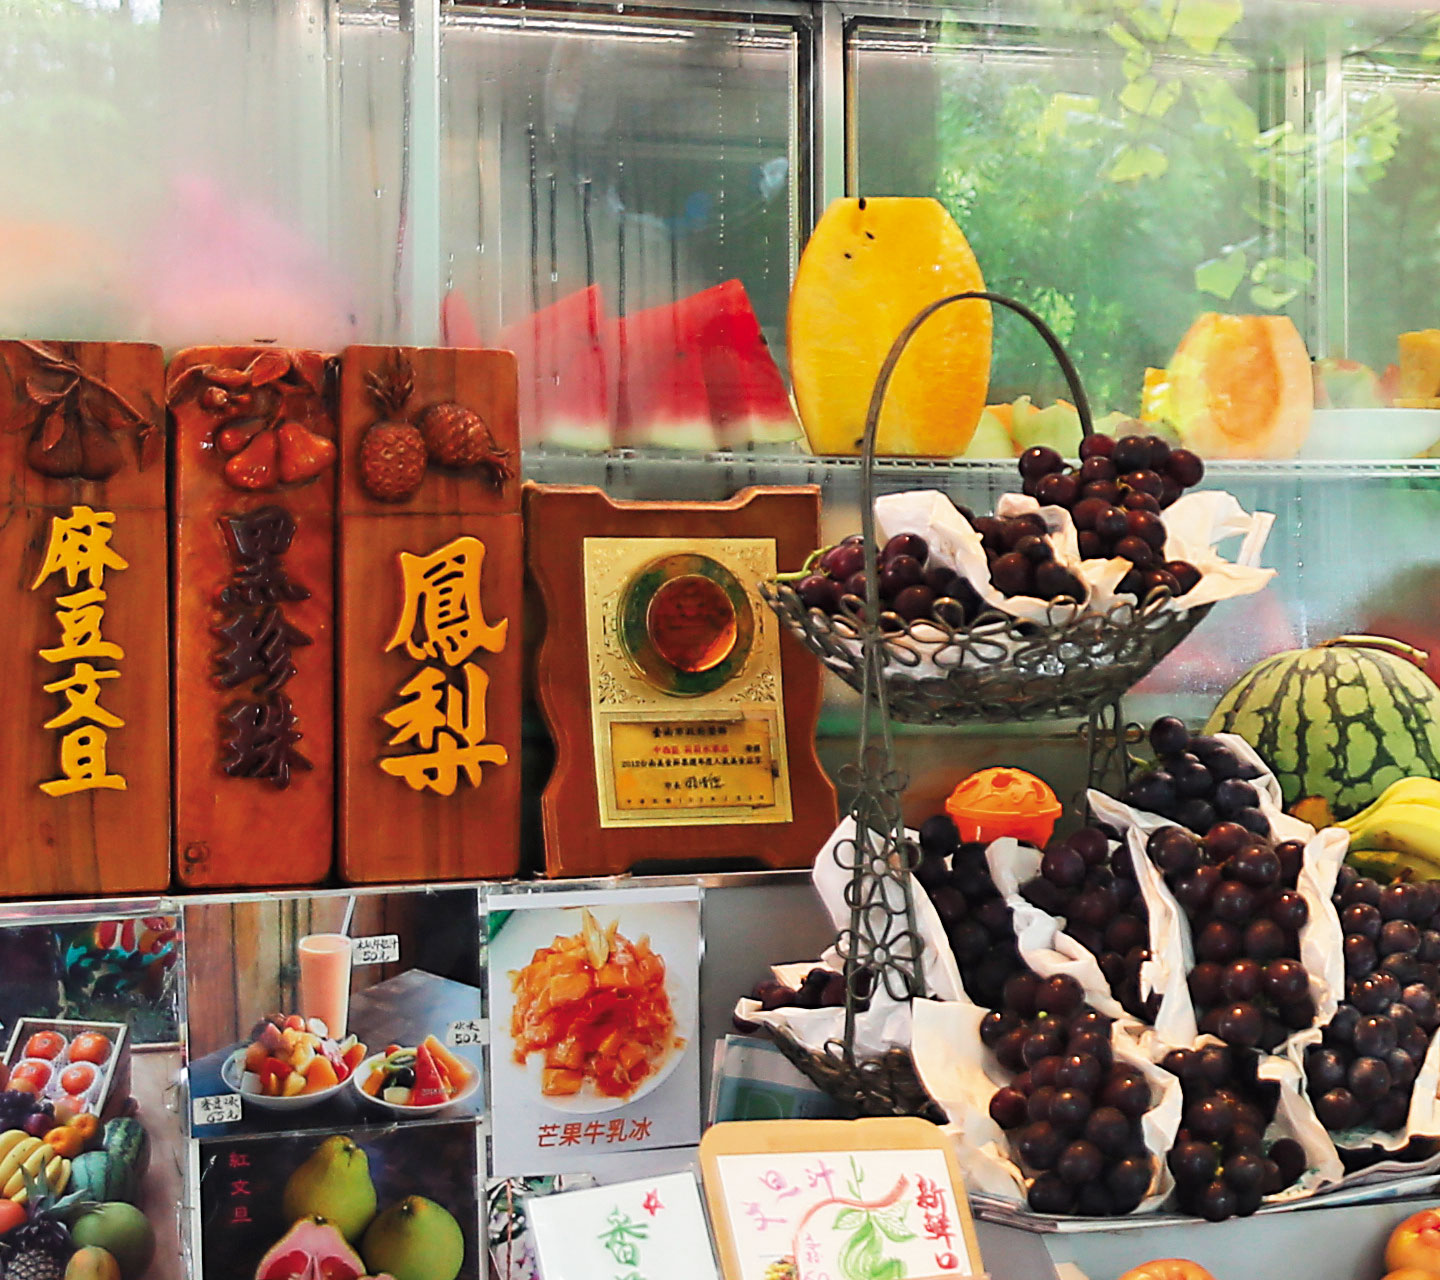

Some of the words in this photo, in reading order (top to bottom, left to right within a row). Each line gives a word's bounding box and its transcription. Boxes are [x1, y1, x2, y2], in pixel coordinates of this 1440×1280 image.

[31, 505, 129, 797] 麻豆文旦
[379, 536, 509, 797] 鳳梨
[228, 1152, 252, 1223] 紅文旦
[537, 1117, 652, 1148] 芒果牛乳冰
